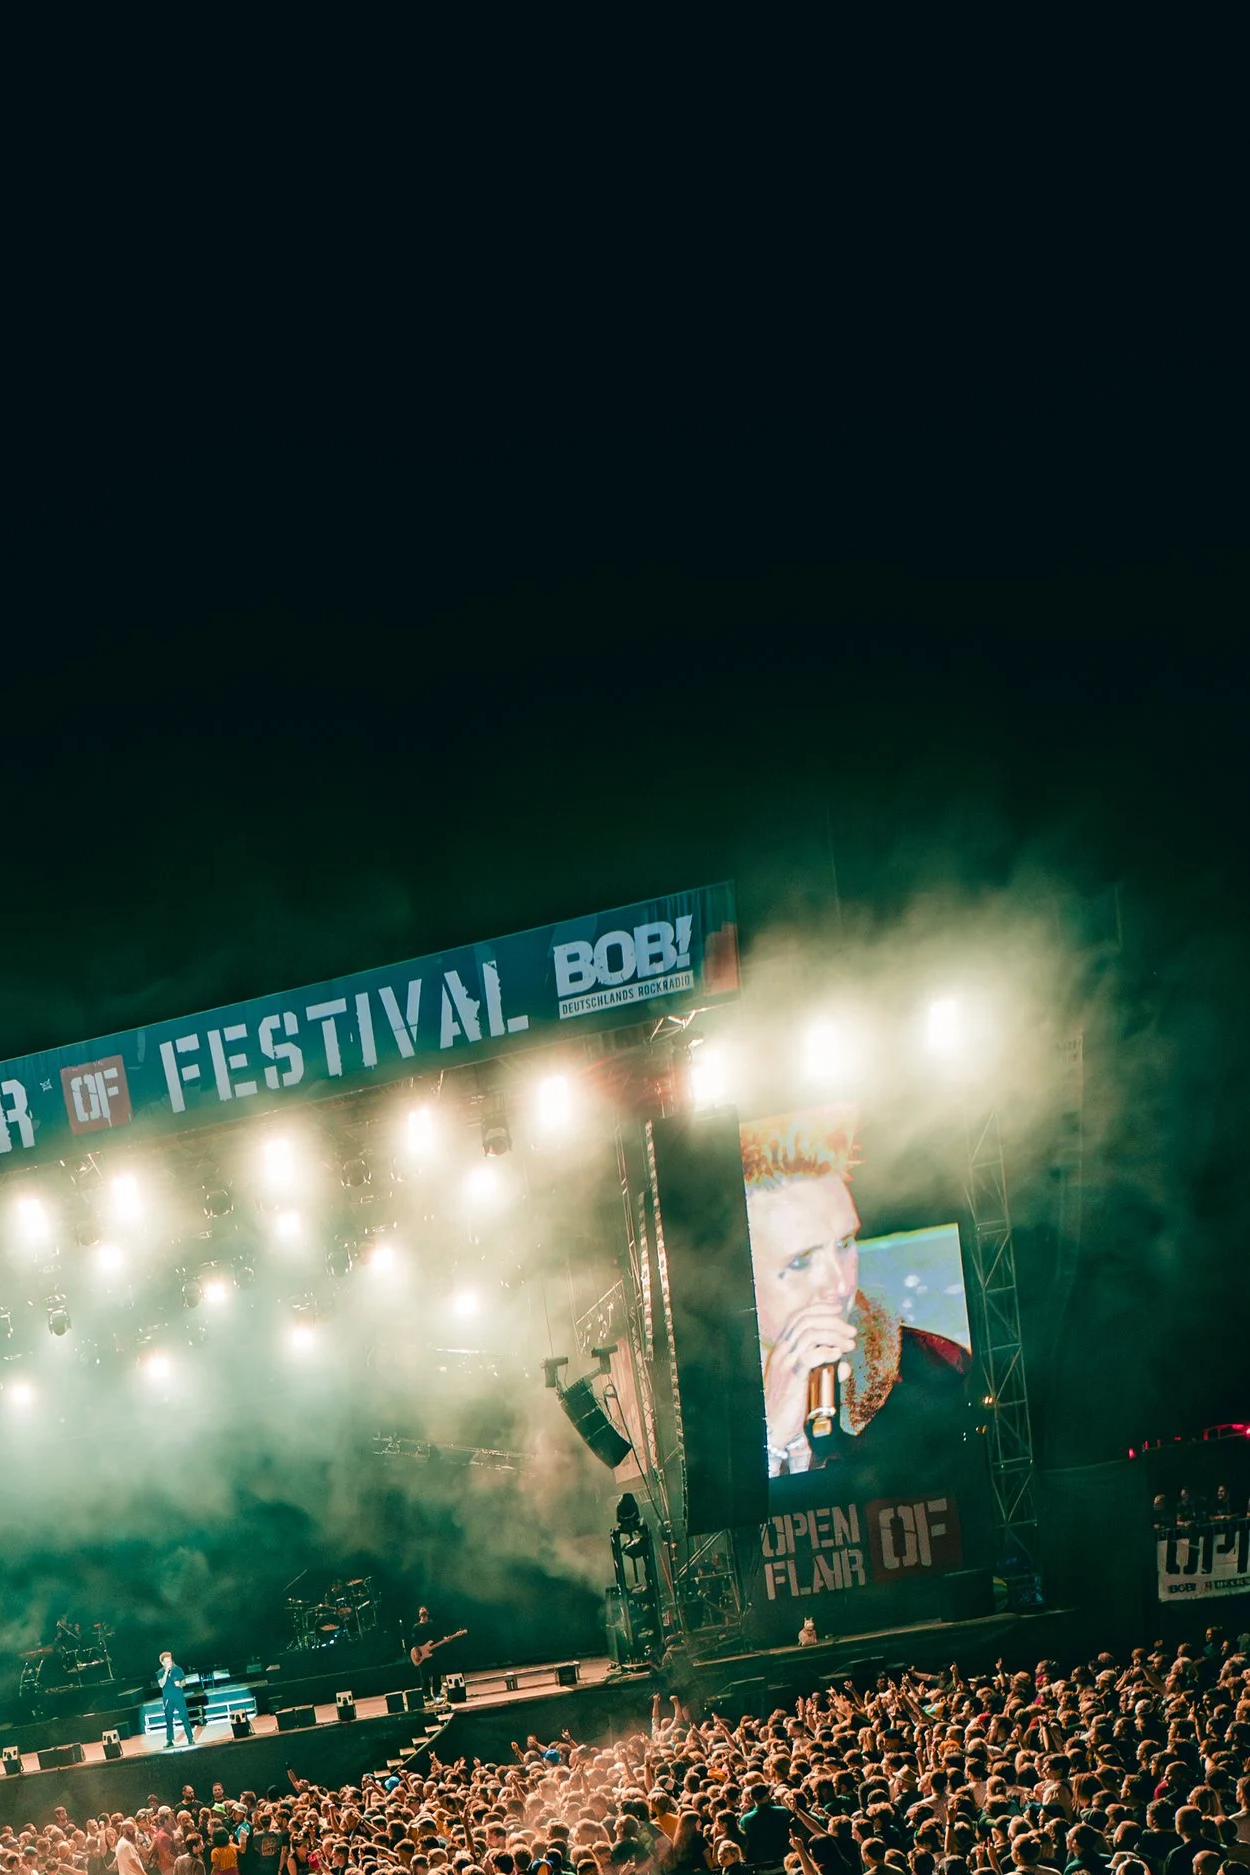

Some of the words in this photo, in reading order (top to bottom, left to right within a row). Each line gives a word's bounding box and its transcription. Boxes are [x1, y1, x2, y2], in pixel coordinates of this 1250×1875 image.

[553, 914, 692, 997] BOB!
[562, 988, 634, 1015] DEUTSCHLANDS
[638, 975, 690, 997] ROCKRADIO
[70, 1067, 120, 1127] OF
[158, 960, 529, 1113] FESTIVAL
[760, 1503, 860, 1557] OPEN
[878, 1498, 949, 1570] OF
[764, 1548, 866, 1601] FLAIR
